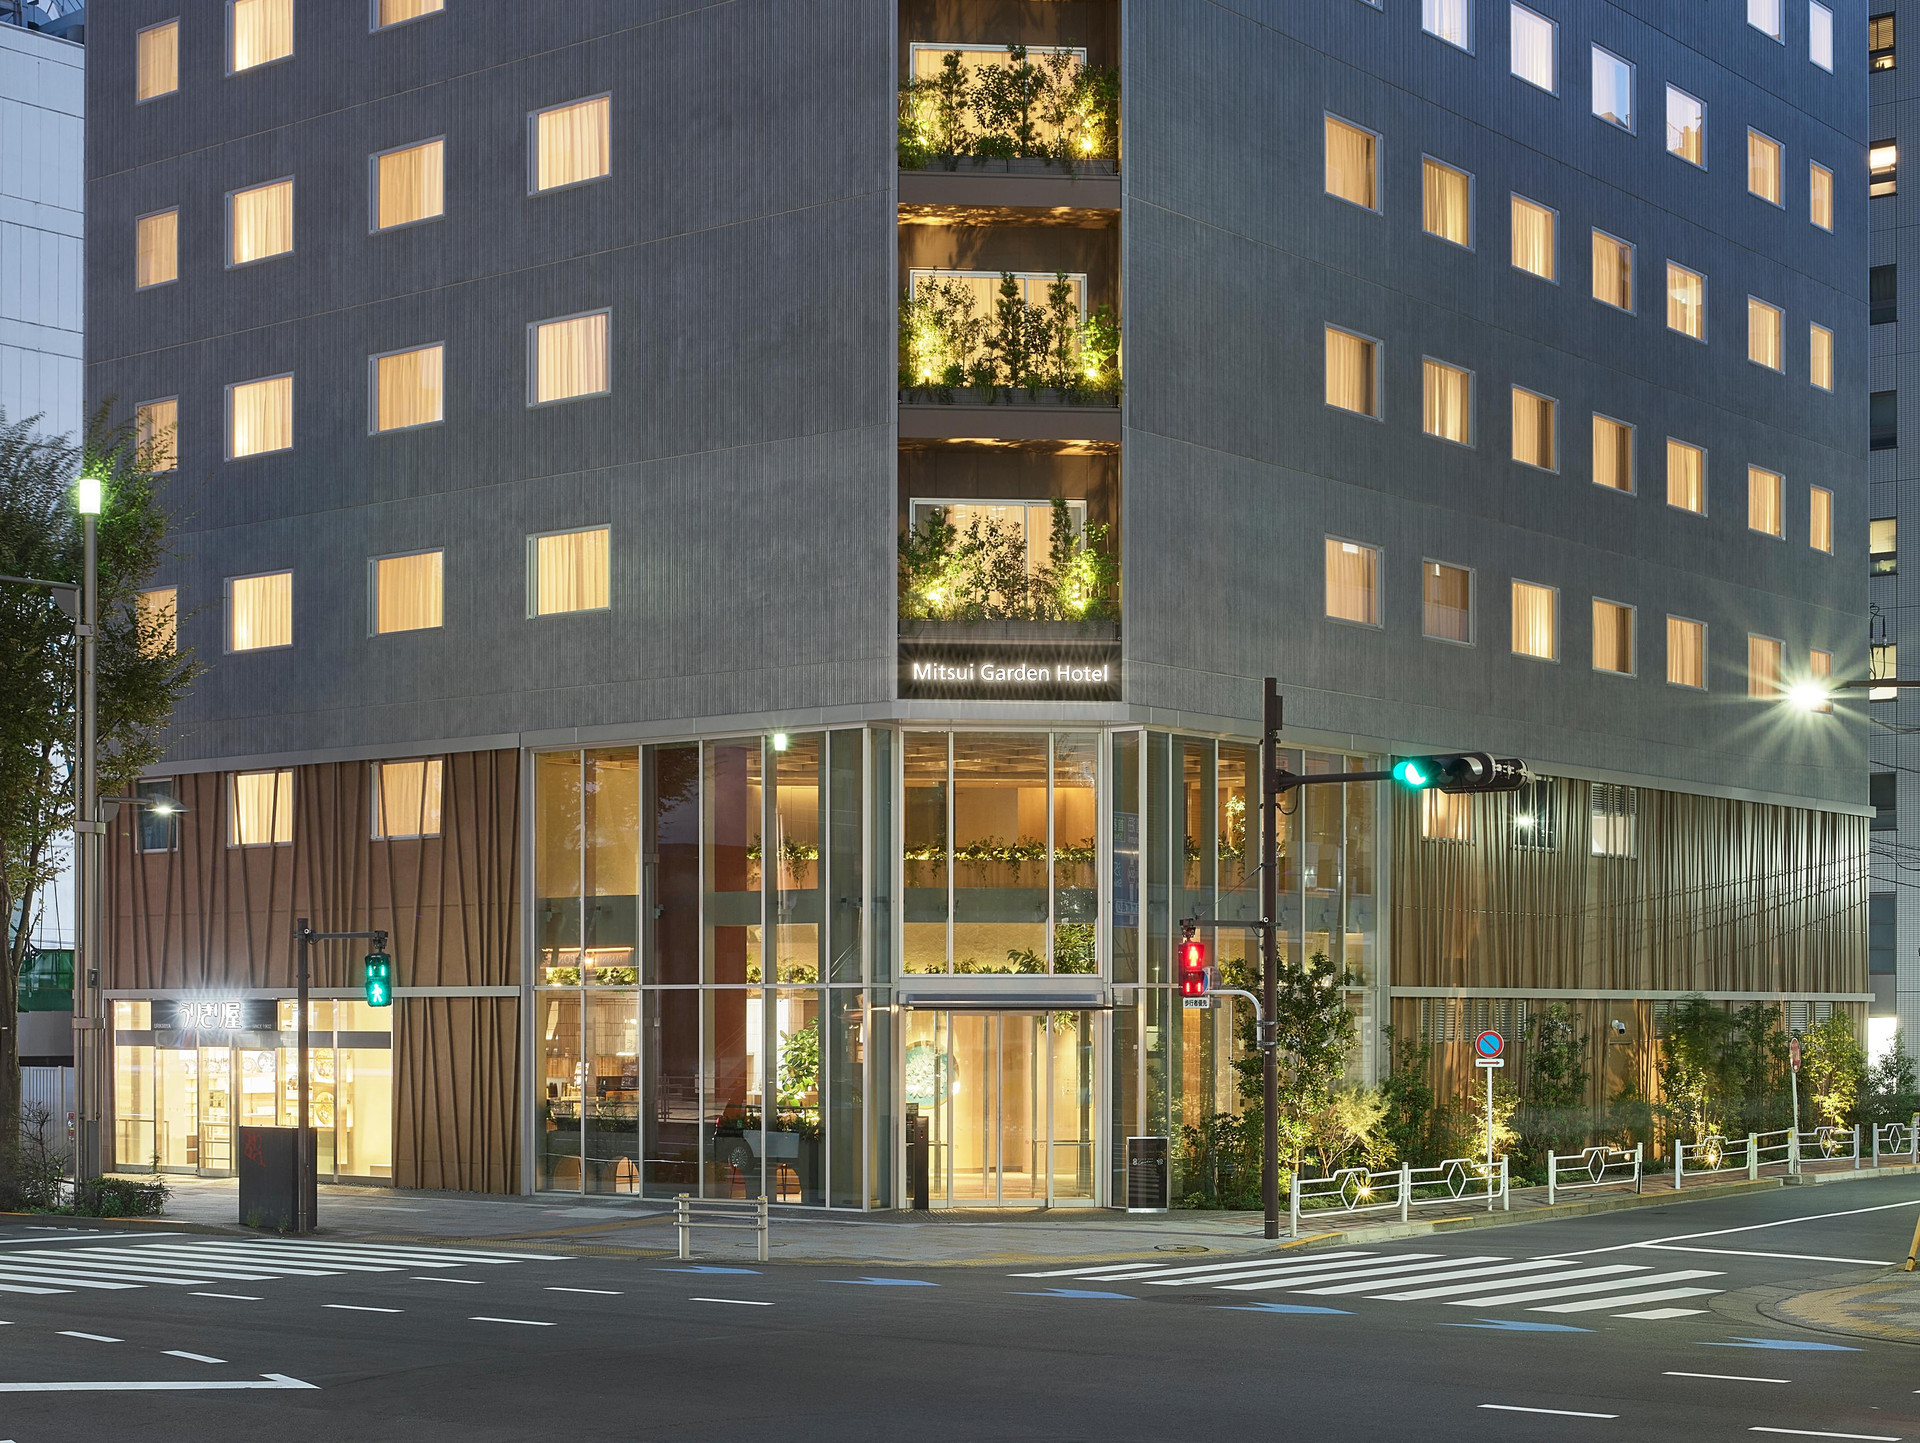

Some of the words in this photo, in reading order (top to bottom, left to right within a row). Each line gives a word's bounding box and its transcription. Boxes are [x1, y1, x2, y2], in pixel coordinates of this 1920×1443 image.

[913, 662, 974, 680] Mitsui
[980, 663, 1050, 681] Garden
[1057, 664, 1108, 682] Hotel
